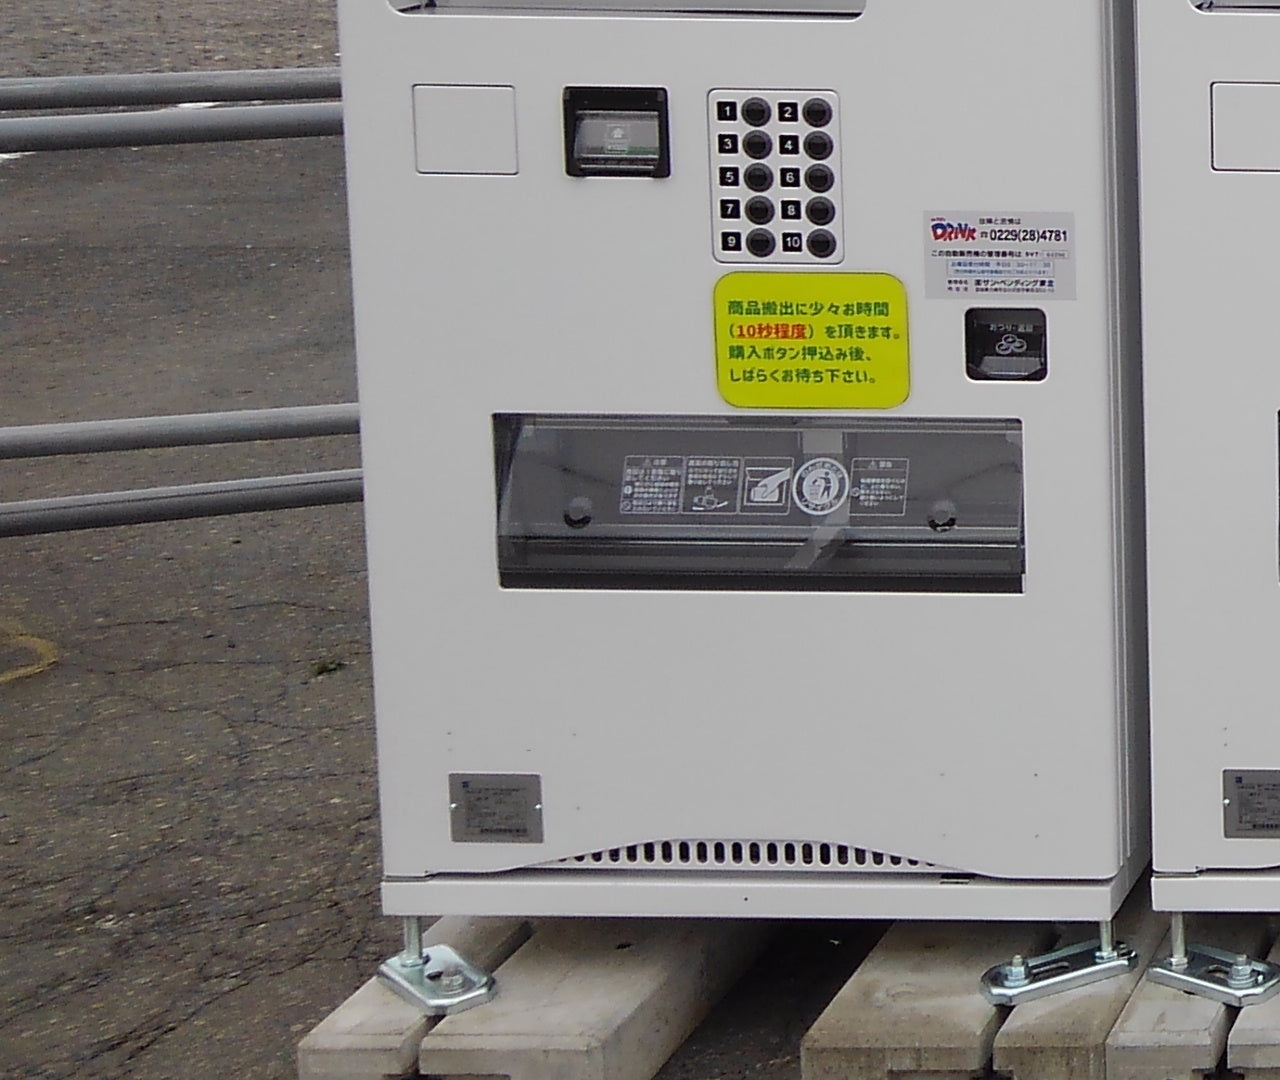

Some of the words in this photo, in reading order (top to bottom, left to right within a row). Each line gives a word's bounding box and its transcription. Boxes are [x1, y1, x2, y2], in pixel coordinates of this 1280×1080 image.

[990, 229, 1067, 242] 0229(28)4781
[727, 301, 890, 317] 商品搬出に少々お時間
[729, 368, 876, 383] しばらくお待ち下さい。
